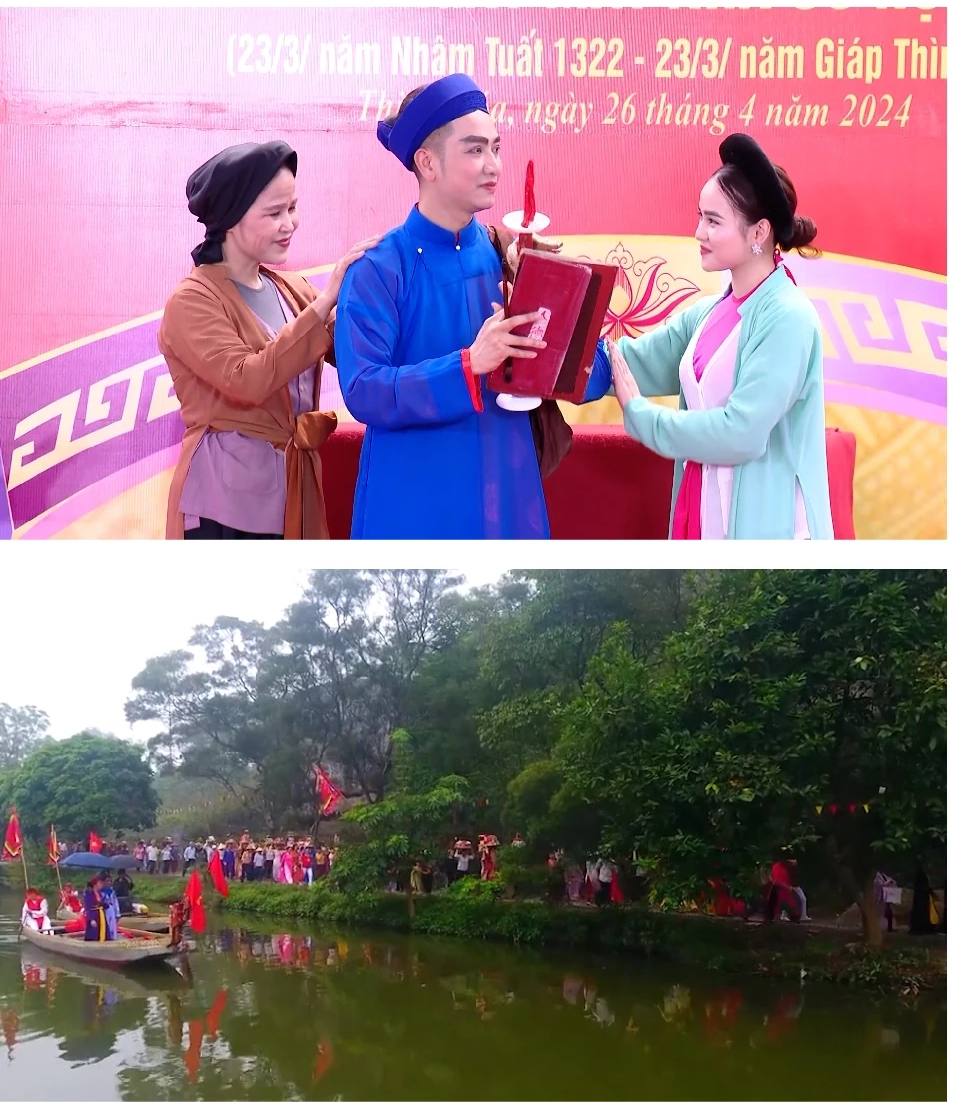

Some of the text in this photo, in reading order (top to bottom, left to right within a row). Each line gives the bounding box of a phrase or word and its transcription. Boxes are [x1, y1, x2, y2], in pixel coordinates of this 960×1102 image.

[226, 33, 312, 77] (23/3/
[319, 35, 381, 75] năm
[392, 34, 475, 76] Nhâm
[485, 29, 543, 77] Tuất
[554, 37, 624, 77] 1322
[635, 56, 645, 65] -
[655, 37, 733, 78] 23/3/
[739, 36, 805, 79] năm
[816, 36, 882, 84] Giáp
[524, 92, 594, 134] ngày
[601, 92, 638, 125] 26
[646, 93, 730, 135] tháng
[738, 93, 756, 127] 4
[765, 94, 829, 127] năm
[839, 93, 912, 128] 2024
